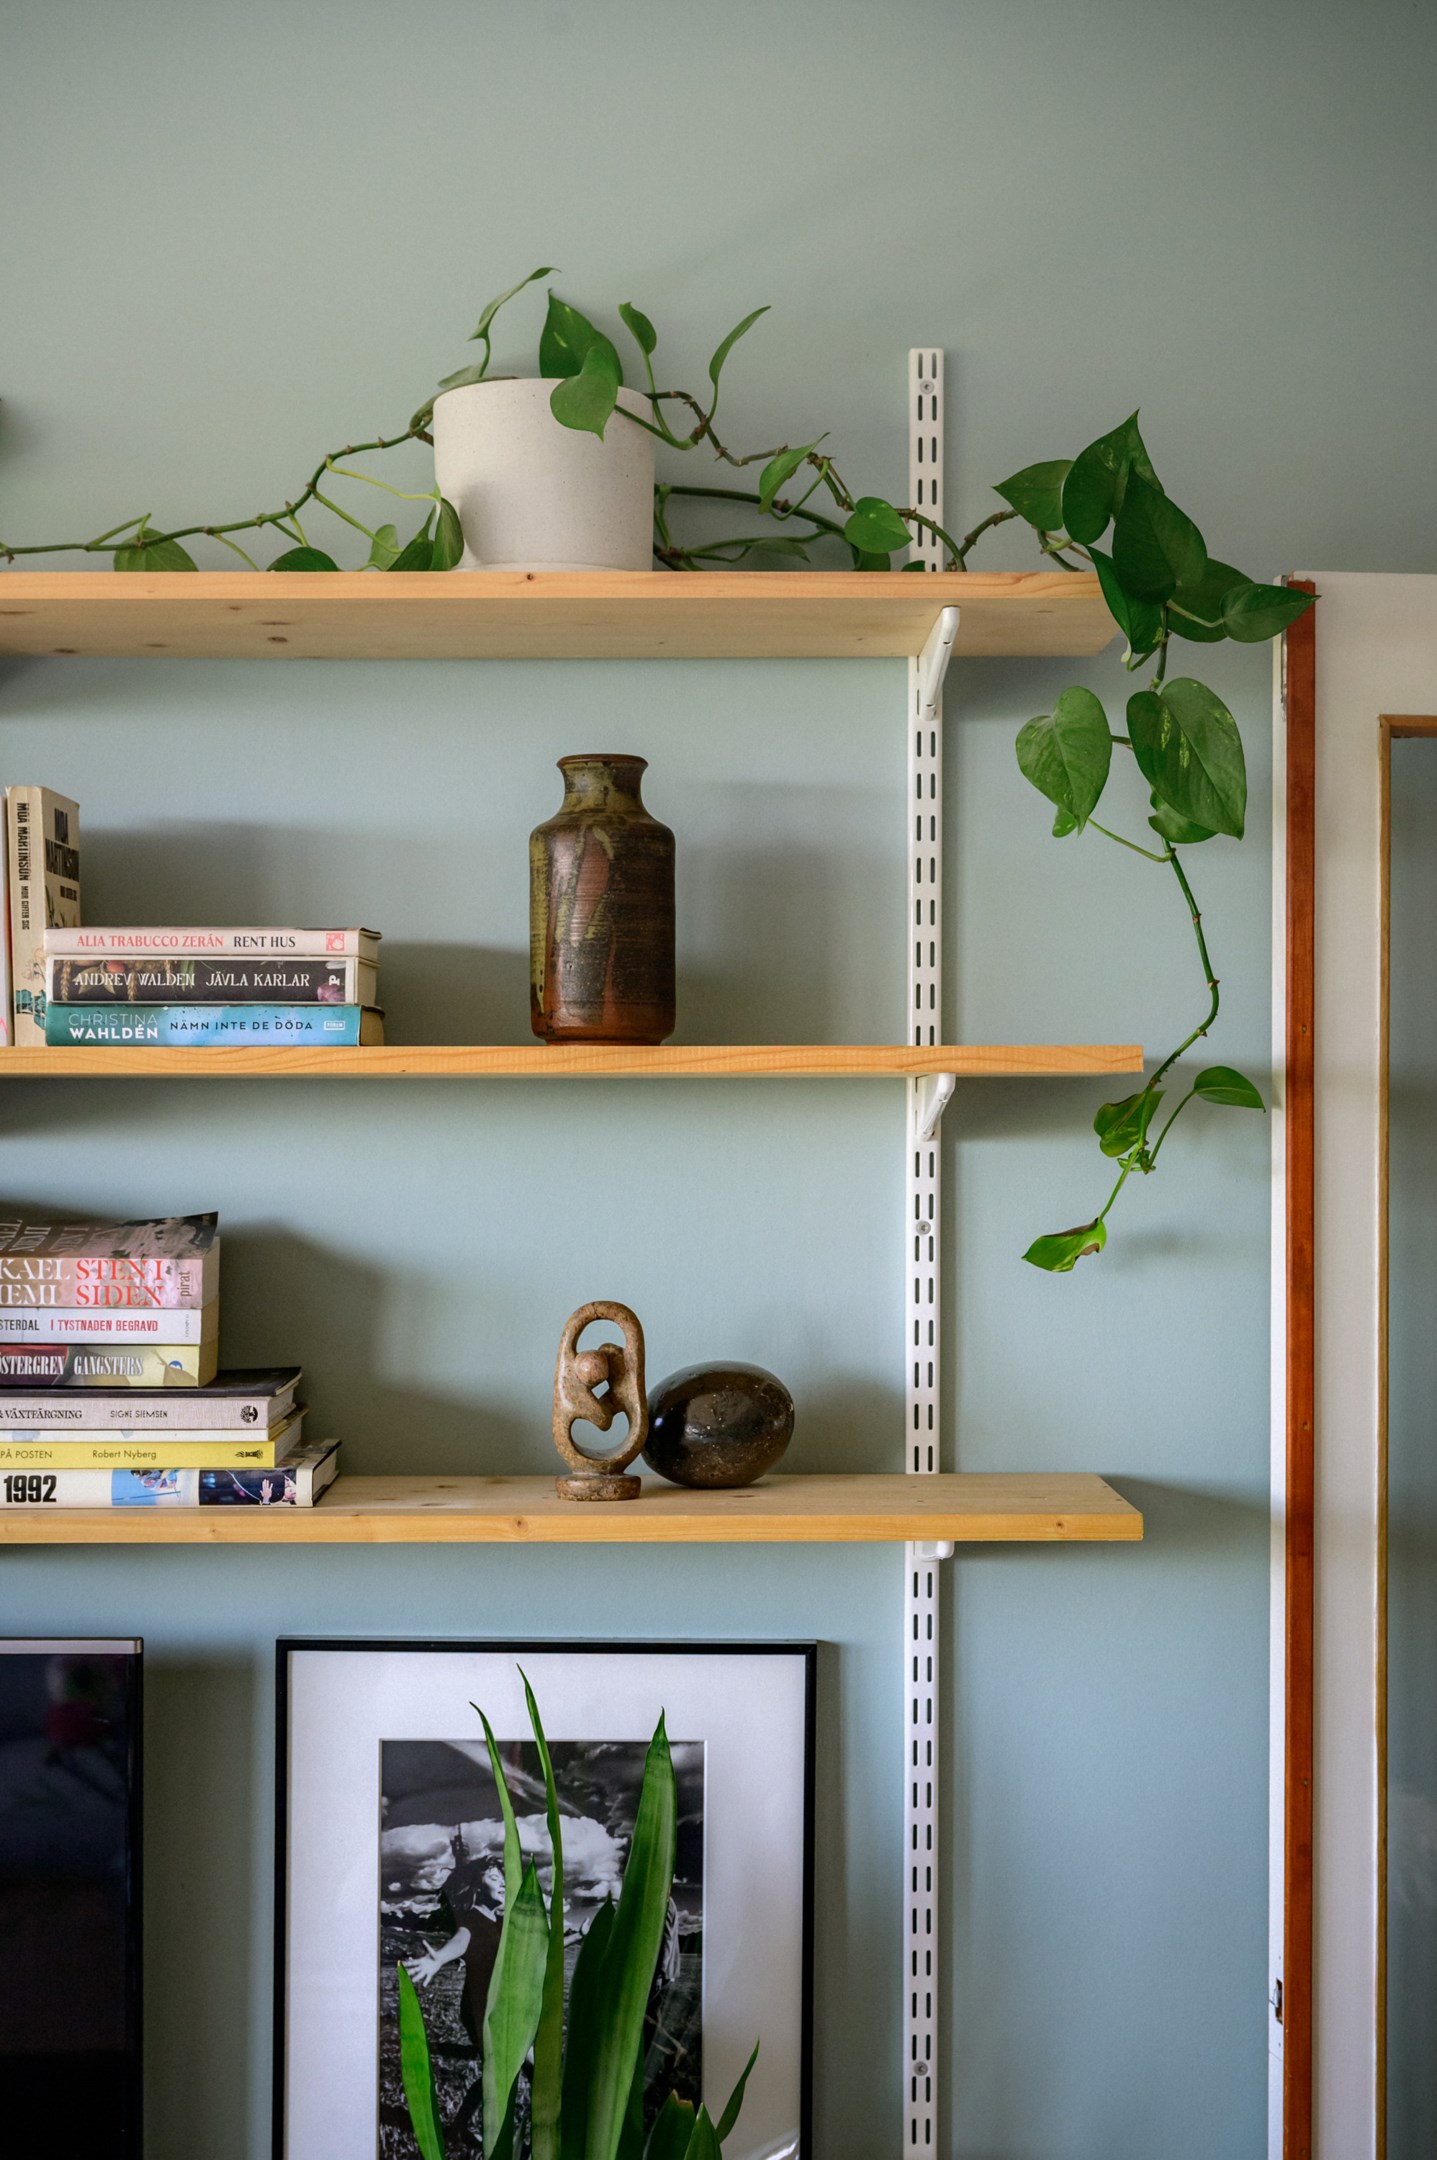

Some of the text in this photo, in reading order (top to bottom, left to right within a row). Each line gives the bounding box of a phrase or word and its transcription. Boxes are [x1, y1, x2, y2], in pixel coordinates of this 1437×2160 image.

[17, 803, 31, 881] MOA MARTINSON
[77, 933, 296, 948] ALIA TRABUCCO ZERÁN RENT HUS
[74, 970, 310, 987] ANDREV WALDEN JÄVLA KARLAR
[68, 1013, 158, 1026] CHRISTINA
[170, 1018, 313, 1030] NÄMN INTE DE DÖDA
[69, 1025, 158, 1039] WAHLDÉN
[76, 1259, 147, 1280] STEN
[156, 1259, 164, 1280] I
[177, 1271, 192, 1297] pirat
[76, 1285, 164, 1306] SIDEN
[50, 1320, 54, 1331] I
[58, 1320, 112, 1331] TYSTNADEN
[116, 1320, 159, 1331] BEGRAVD
[74, 1355, 145, 1376] GANGSTERS
[5, 1407, 83, 1419] VÄXTFÄRGNING
[110, 1410, 133, 1419] SIGNE
[135, 1410, 169, 1419] SIEMSEN
[0, 1448, 158, 1461] PÅ POSTEN Robert Nyberg
[3, 1475, 57, 1503] 1992
